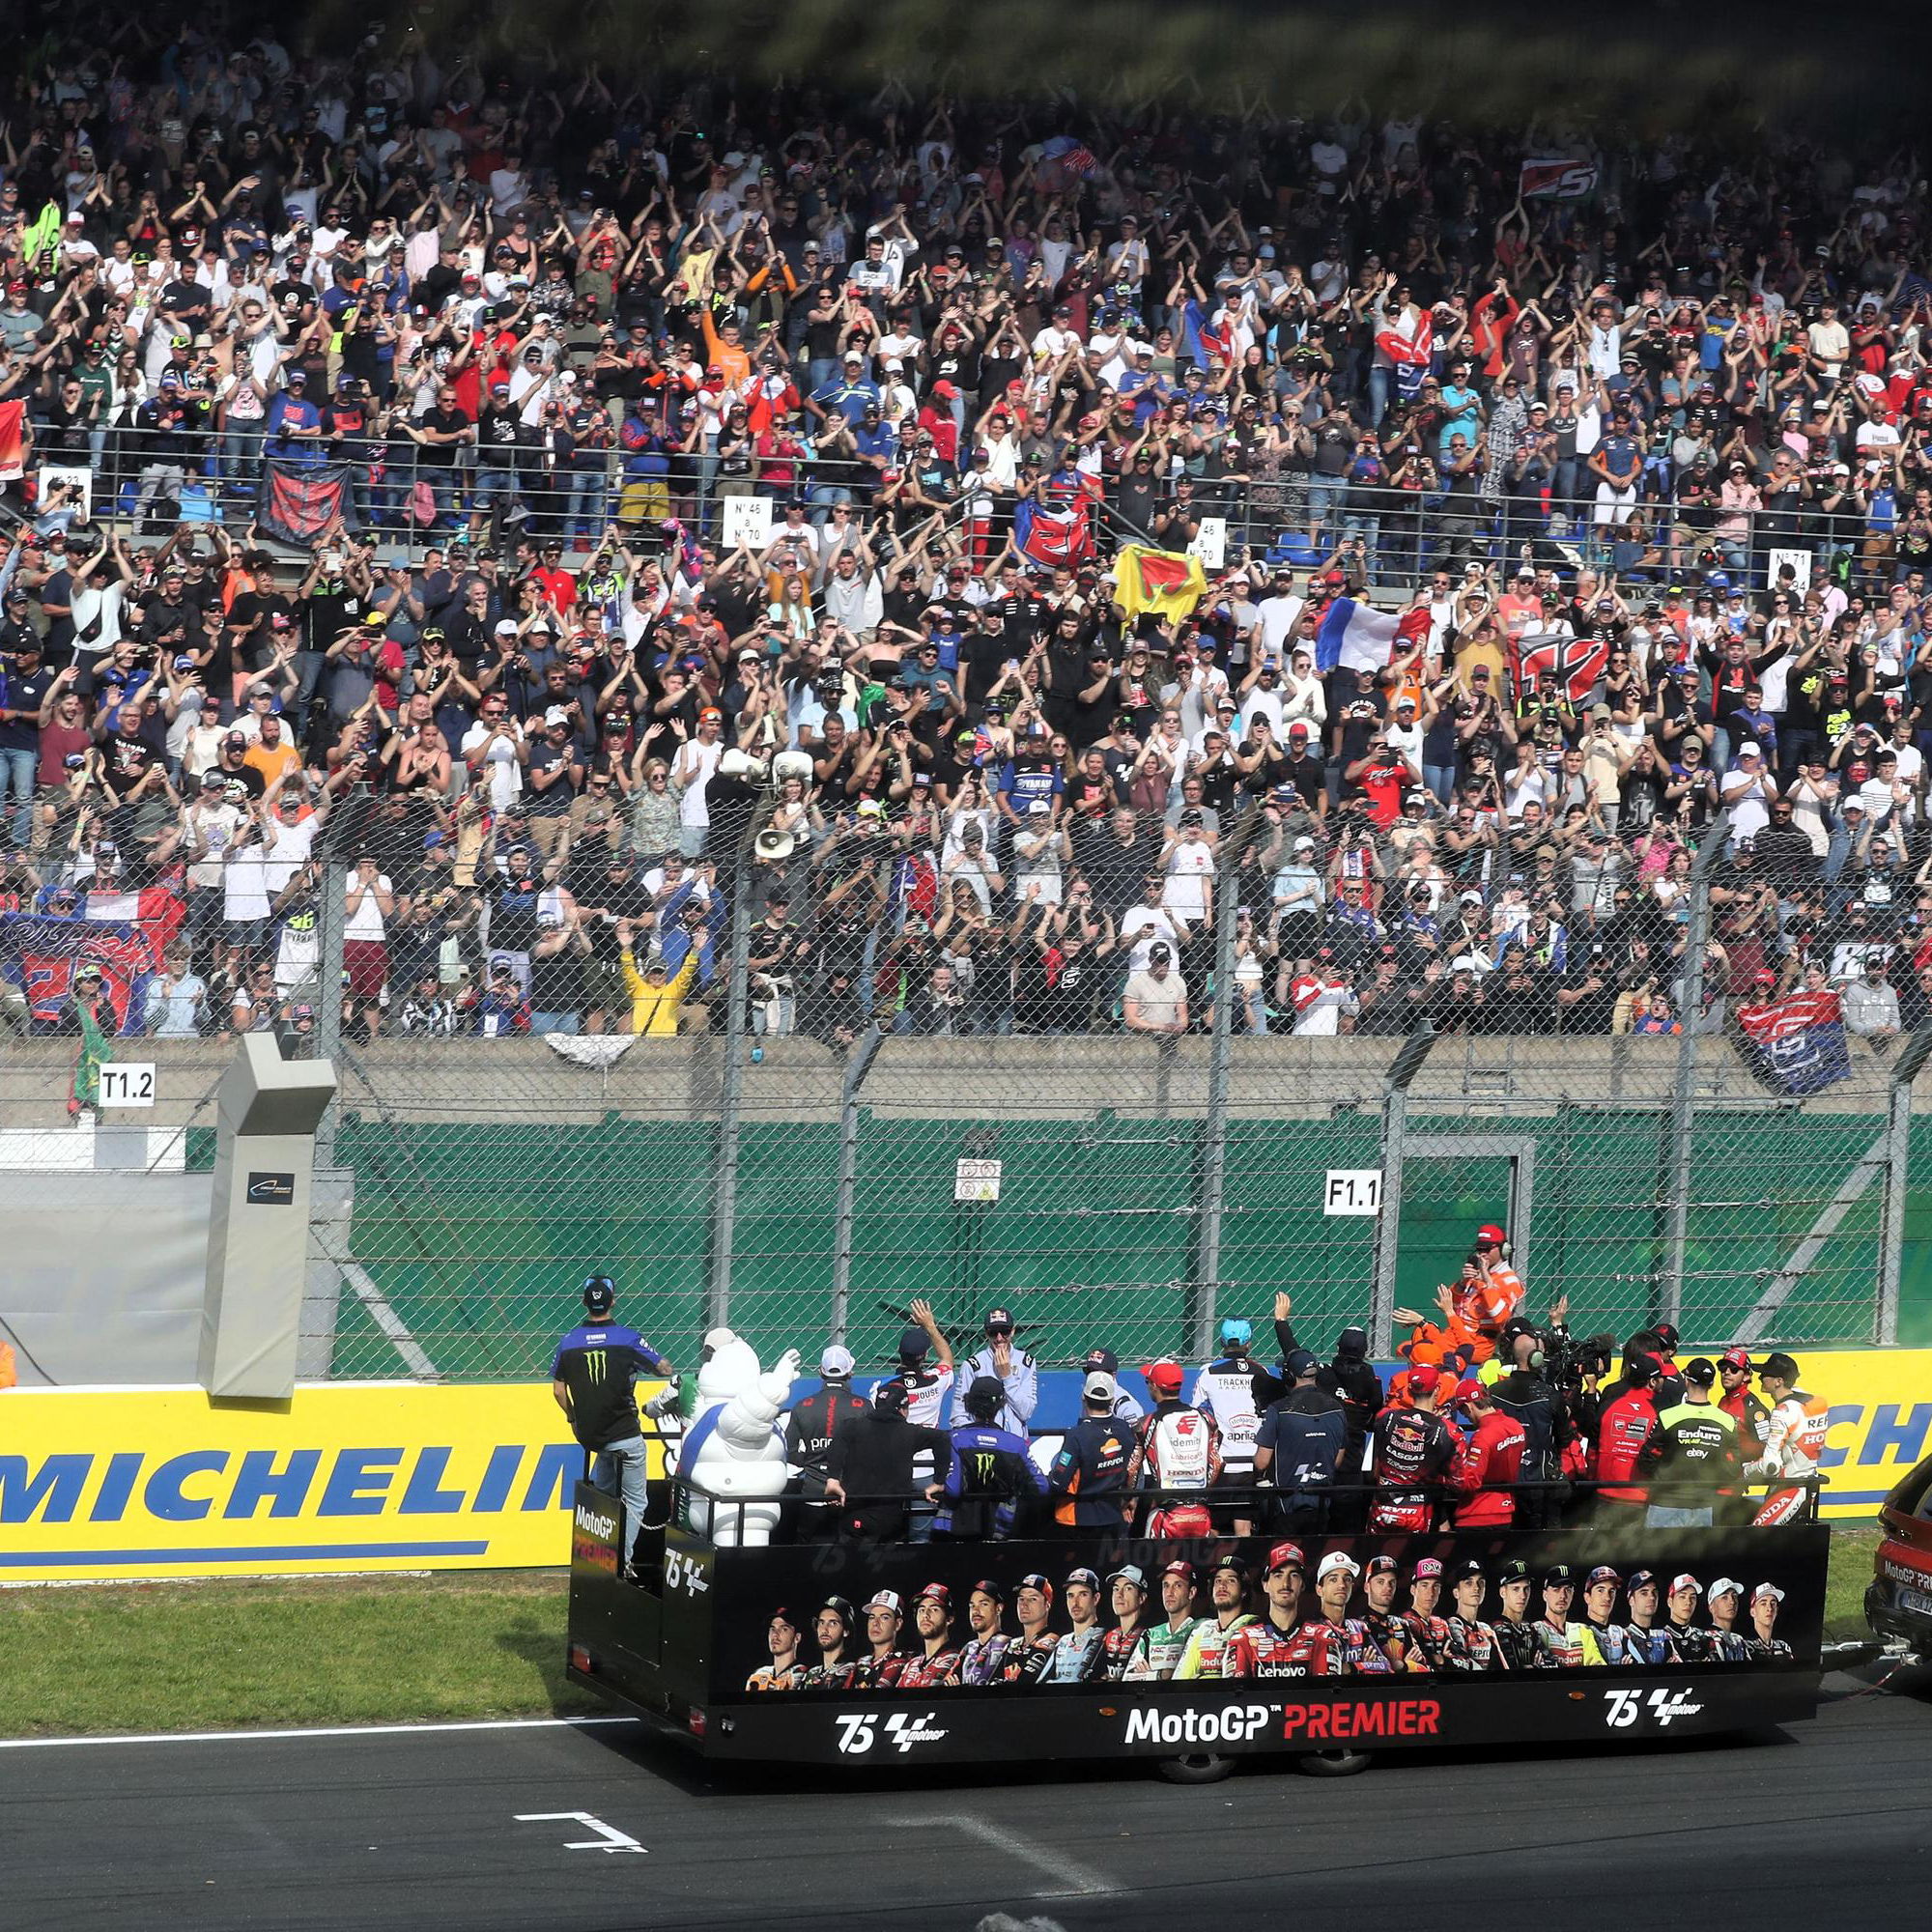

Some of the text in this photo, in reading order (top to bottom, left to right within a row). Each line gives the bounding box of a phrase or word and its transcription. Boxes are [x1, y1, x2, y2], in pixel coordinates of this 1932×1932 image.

[749, 503, 761, 514] 46
[748, 529, 760, 540] 70
[1203, 526, 1214, 535] 46
[1203, 550, 1213, 560] 70
[1794, 554, 1805, 564] 71
[102, 1072, 153, 1098] T1.2
[1329, 1179, 1377, 1207] F1.1
[1218, 1378, 1251, 1386] TRACKH
[1678, 1429, 1722, 1442] Enduro
[1686, 1448, 1708, 1459] ebay
[1258, 1664, 1306, 1678] Lenovo
[1604, 1690, 1642, 1728] 75
[1283, 1699, 1441, 1740] PREMIER
[835, 1714, 879, 1754] 75
